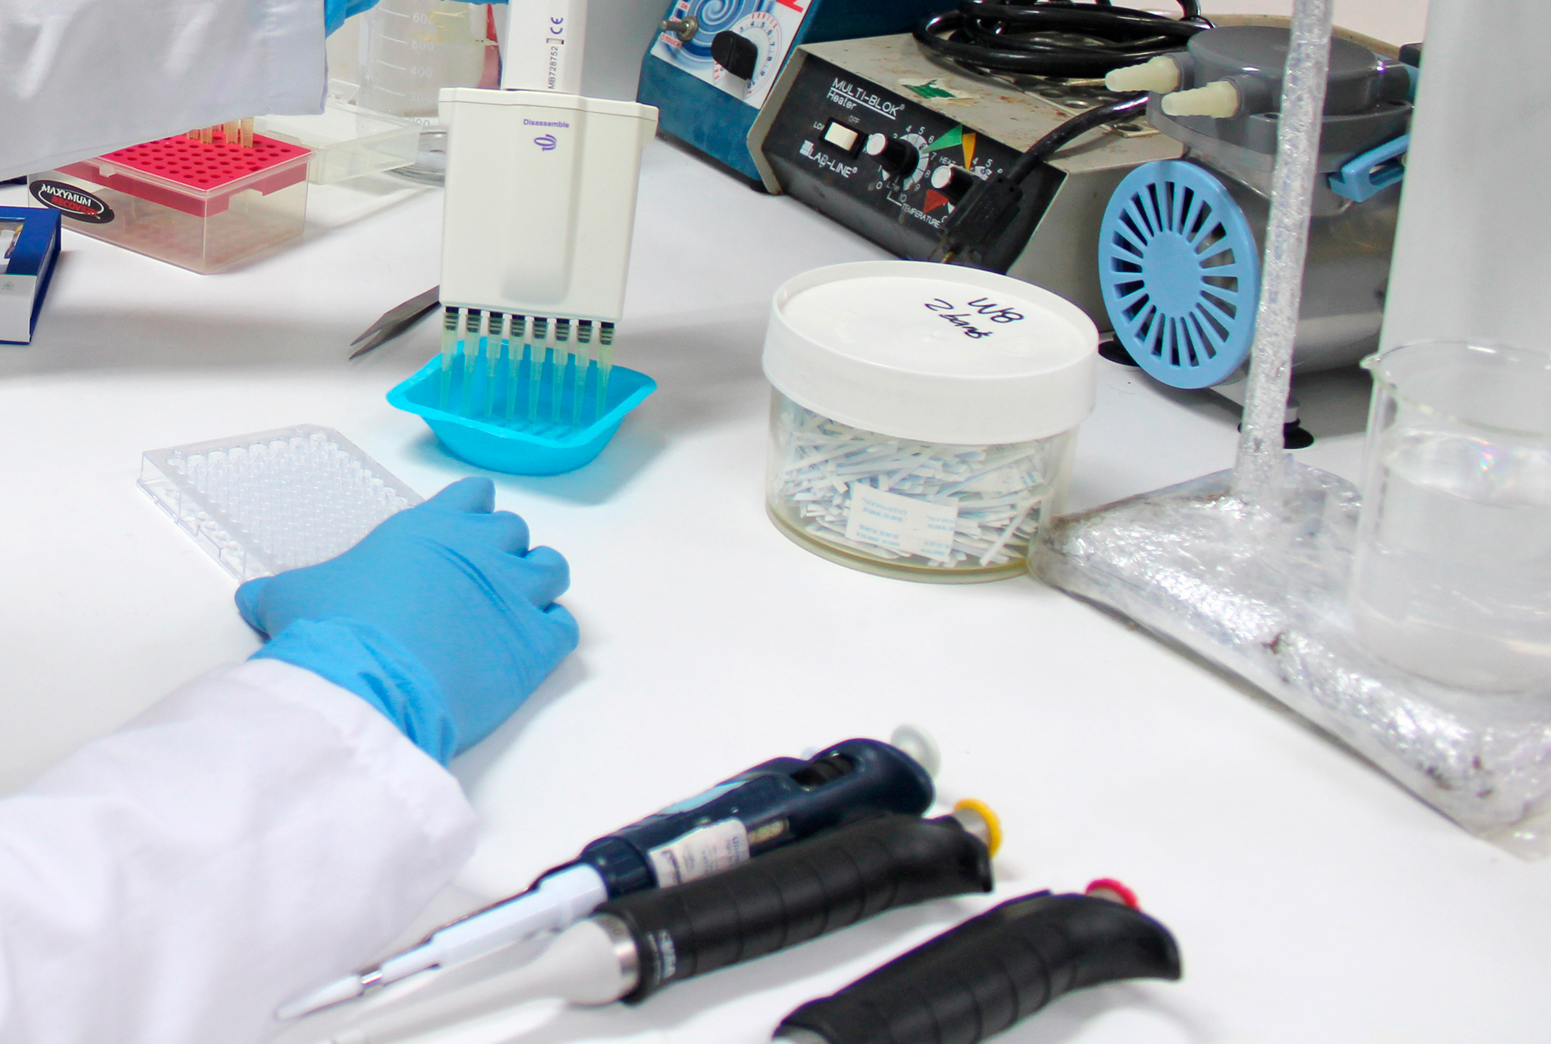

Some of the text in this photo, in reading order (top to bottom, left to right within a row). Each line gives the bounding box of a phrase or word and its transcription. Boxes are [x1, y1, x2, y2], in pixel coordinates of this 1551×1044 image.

[412, 13, 431, 25] 60
[548, 45, 559, 90] MB728752
[826, 90, 858, 111] Heater
[523, 118, 570, 129] Disassemble
[848, 115, 860, 124] OFF
[905, 124, 912, 133] 4
[918, 126, 926, 135] 5
[928, 135, 935, 144] 6
[930, 151, 938, 161] 7
[972, 157, 979, 165] 4
[985, 158, 993, 168] 5
[875, 181, 883, 190] 0
[914, 182, 921, 192] 9
[41, 183, 92, 207] MAXYMUM
[898, 193, 908, 203] 10
[901, 202, 941, 229] TEMPERATURE
